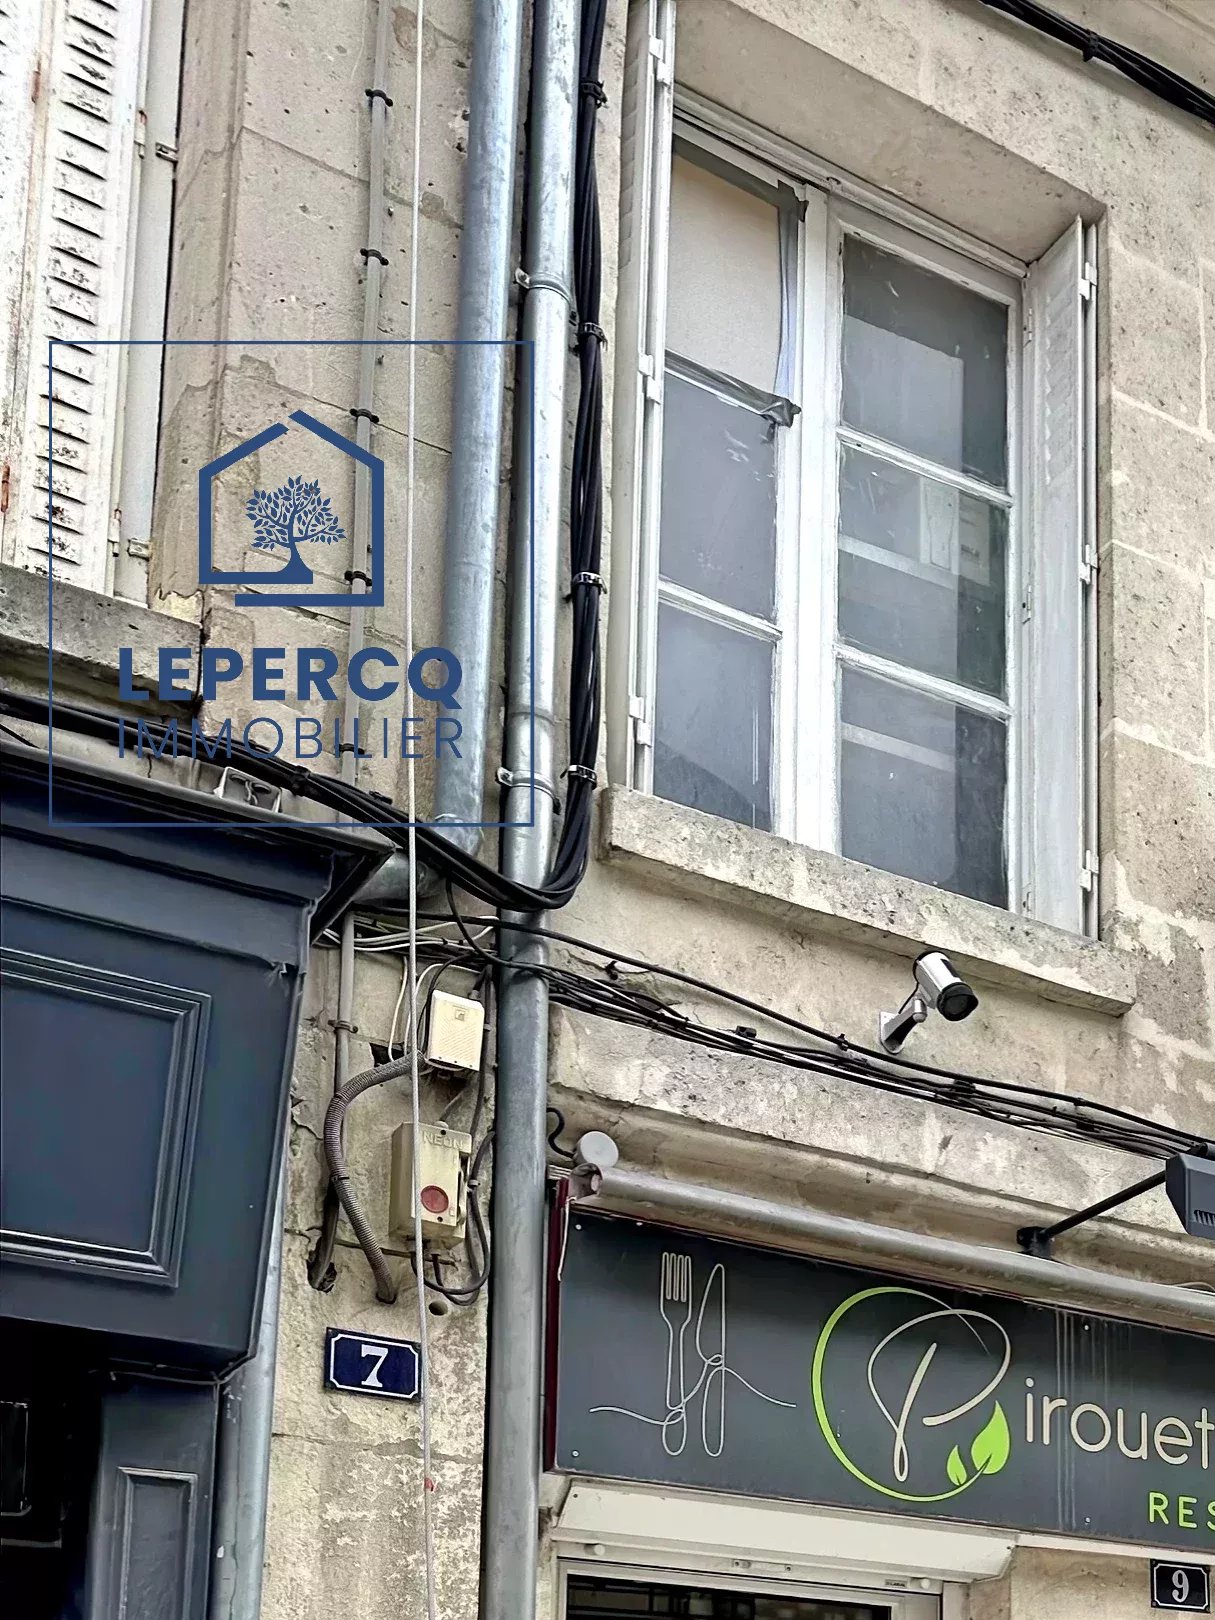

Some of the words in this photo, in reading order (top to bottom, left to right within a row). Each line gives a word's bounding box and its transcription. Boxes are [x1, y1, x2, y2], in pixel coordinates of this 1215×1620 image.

[422, 1130, 465, 1151] NEON
[360, 1343, 389, 1388] 7
[1170, 1569, 1191, 1604] 9
